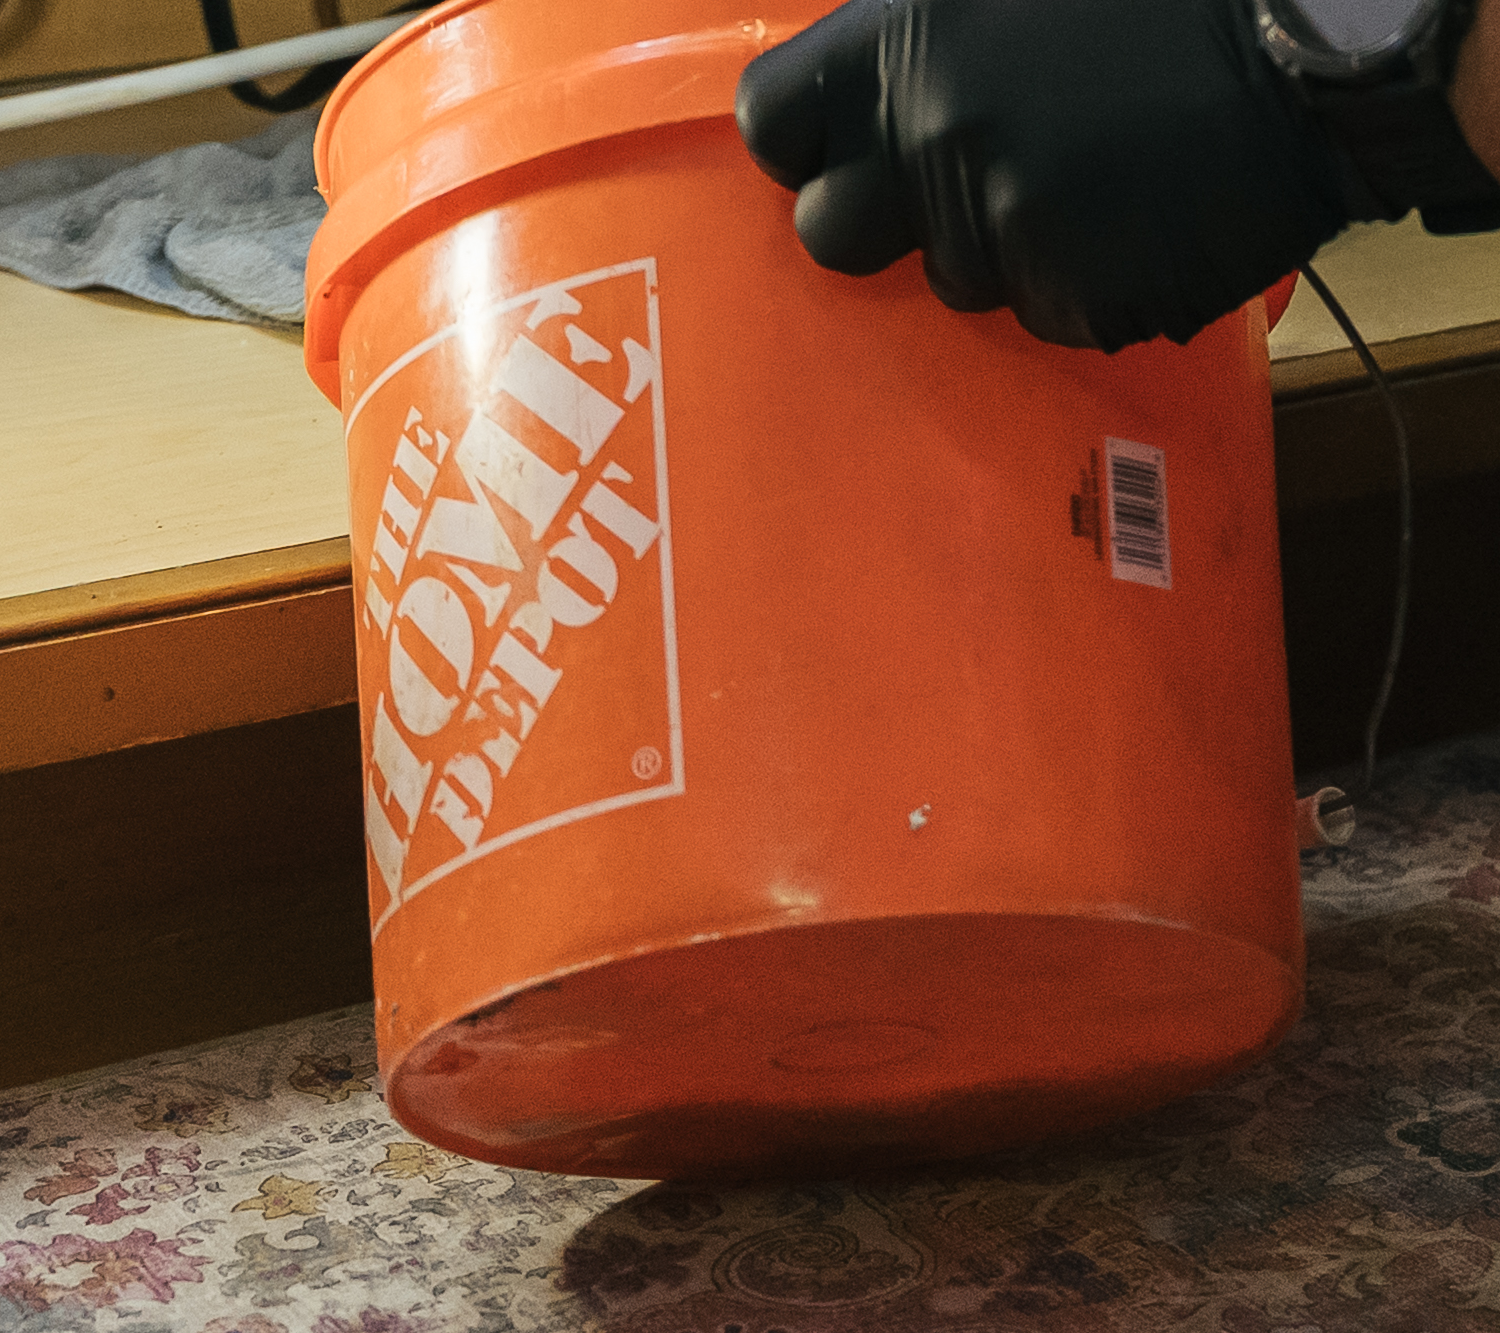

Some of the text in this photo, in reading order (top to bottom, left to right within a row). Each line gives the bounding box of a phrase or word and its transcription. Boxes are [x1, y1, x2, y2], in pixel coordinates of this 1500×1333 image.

[362, 404, 451, 640] THE
[366, 288, 659, 907] HOME
[429, 463, 663, 855] DEPOT
